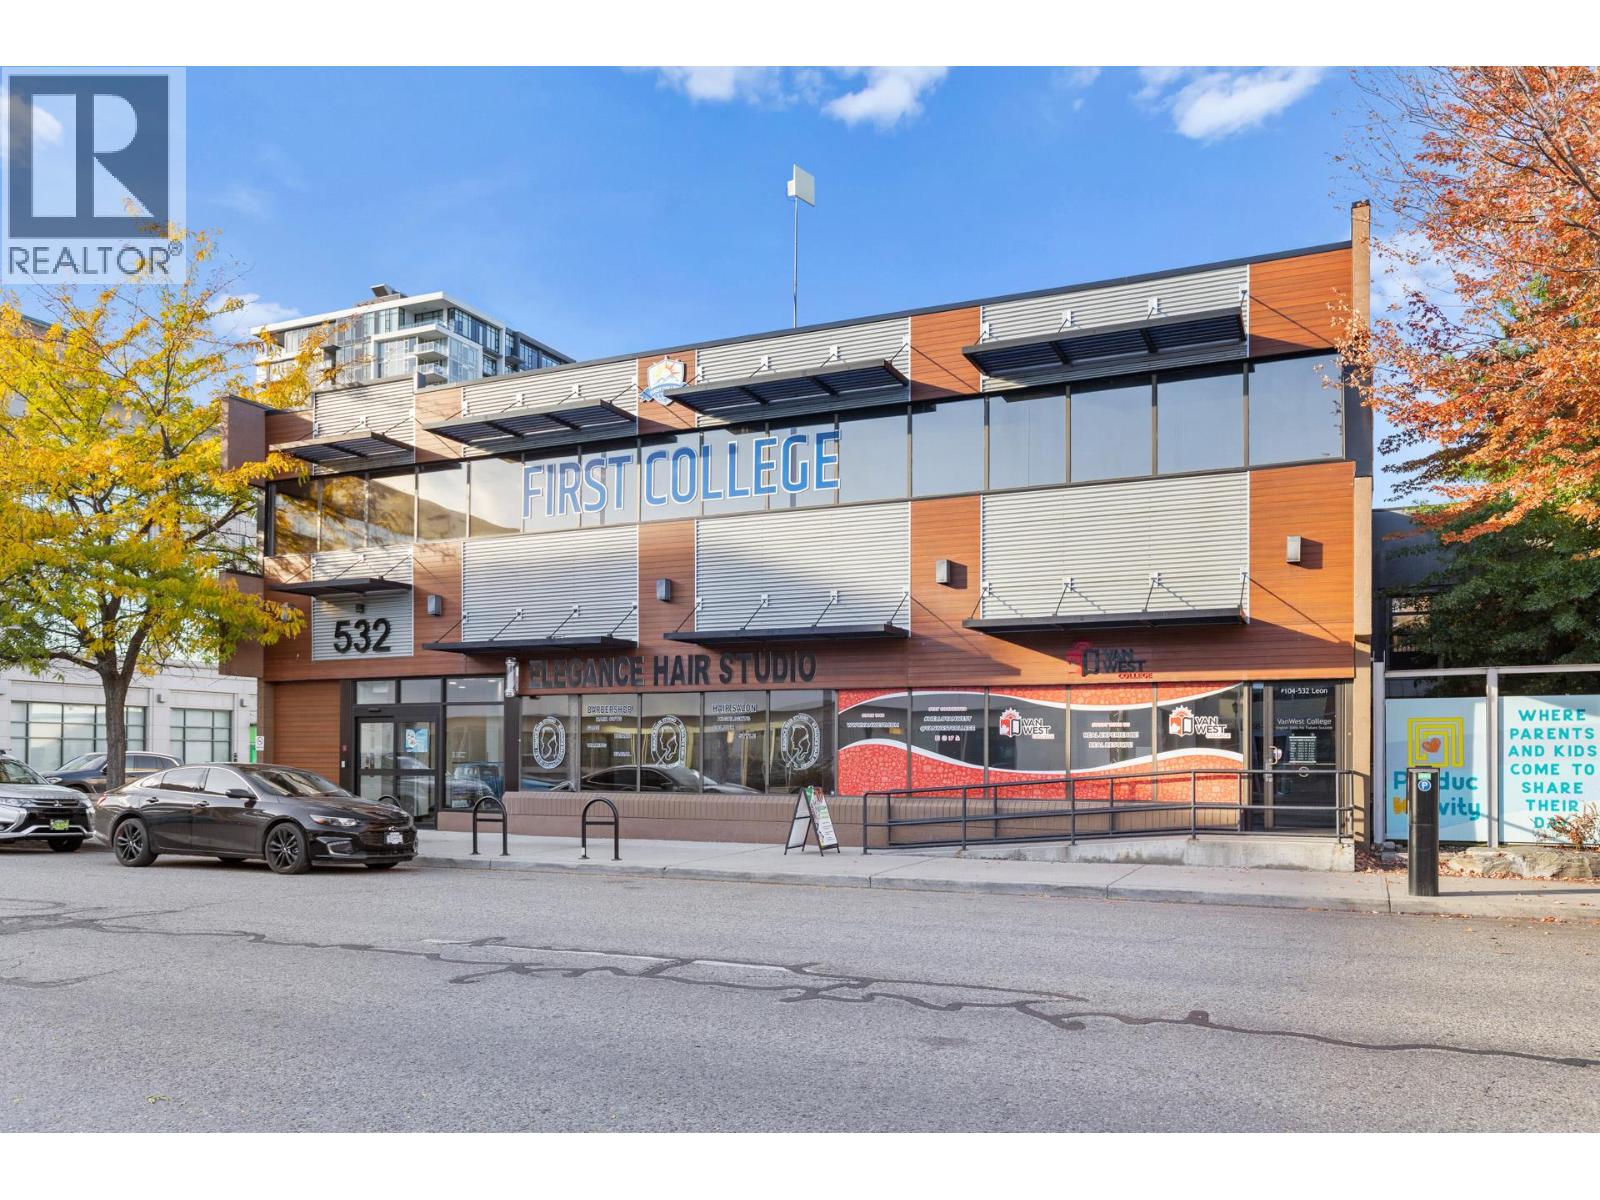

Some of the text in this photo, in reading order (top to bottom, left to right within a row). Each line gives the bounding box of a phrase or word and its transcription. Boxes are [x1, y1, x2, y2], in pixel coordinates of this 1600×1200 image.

[522, 430, 842, 519] FIRST COLLEGE
[333, 618, 392, 654] 532
[1103, 648, 1134, 660] VAN
[528, 651, 817, 689] ELEGANCE HAIR STUDIO
[1103, 659, 1147, 673] WEST
[1118, 672, 1153, 680] COLLEGE
[1280, 687, 1328, 695] #104-532 Leon
[587, 703, 634, 714] BARBERSHOP
[1195, 716, 1219, 725] VAN
[1518, 708, 1586, 722] WHERE
[1022, 718, 1043, 726] VAN
[1276, 718, 1333, 726] VanWest College
[1022, 726, 1052, 735] WEST
[1195, 724, 1228, 735] WEST
[1510, 727, 1595, 740] PARENTS
[1508, 744, 1597, 757] AND KIDS
[1510, 763, 1595, 776] COME TO
[1521, 782, 1584, 794] SHARE
[1526, 799, 1579, 812] THEIR
